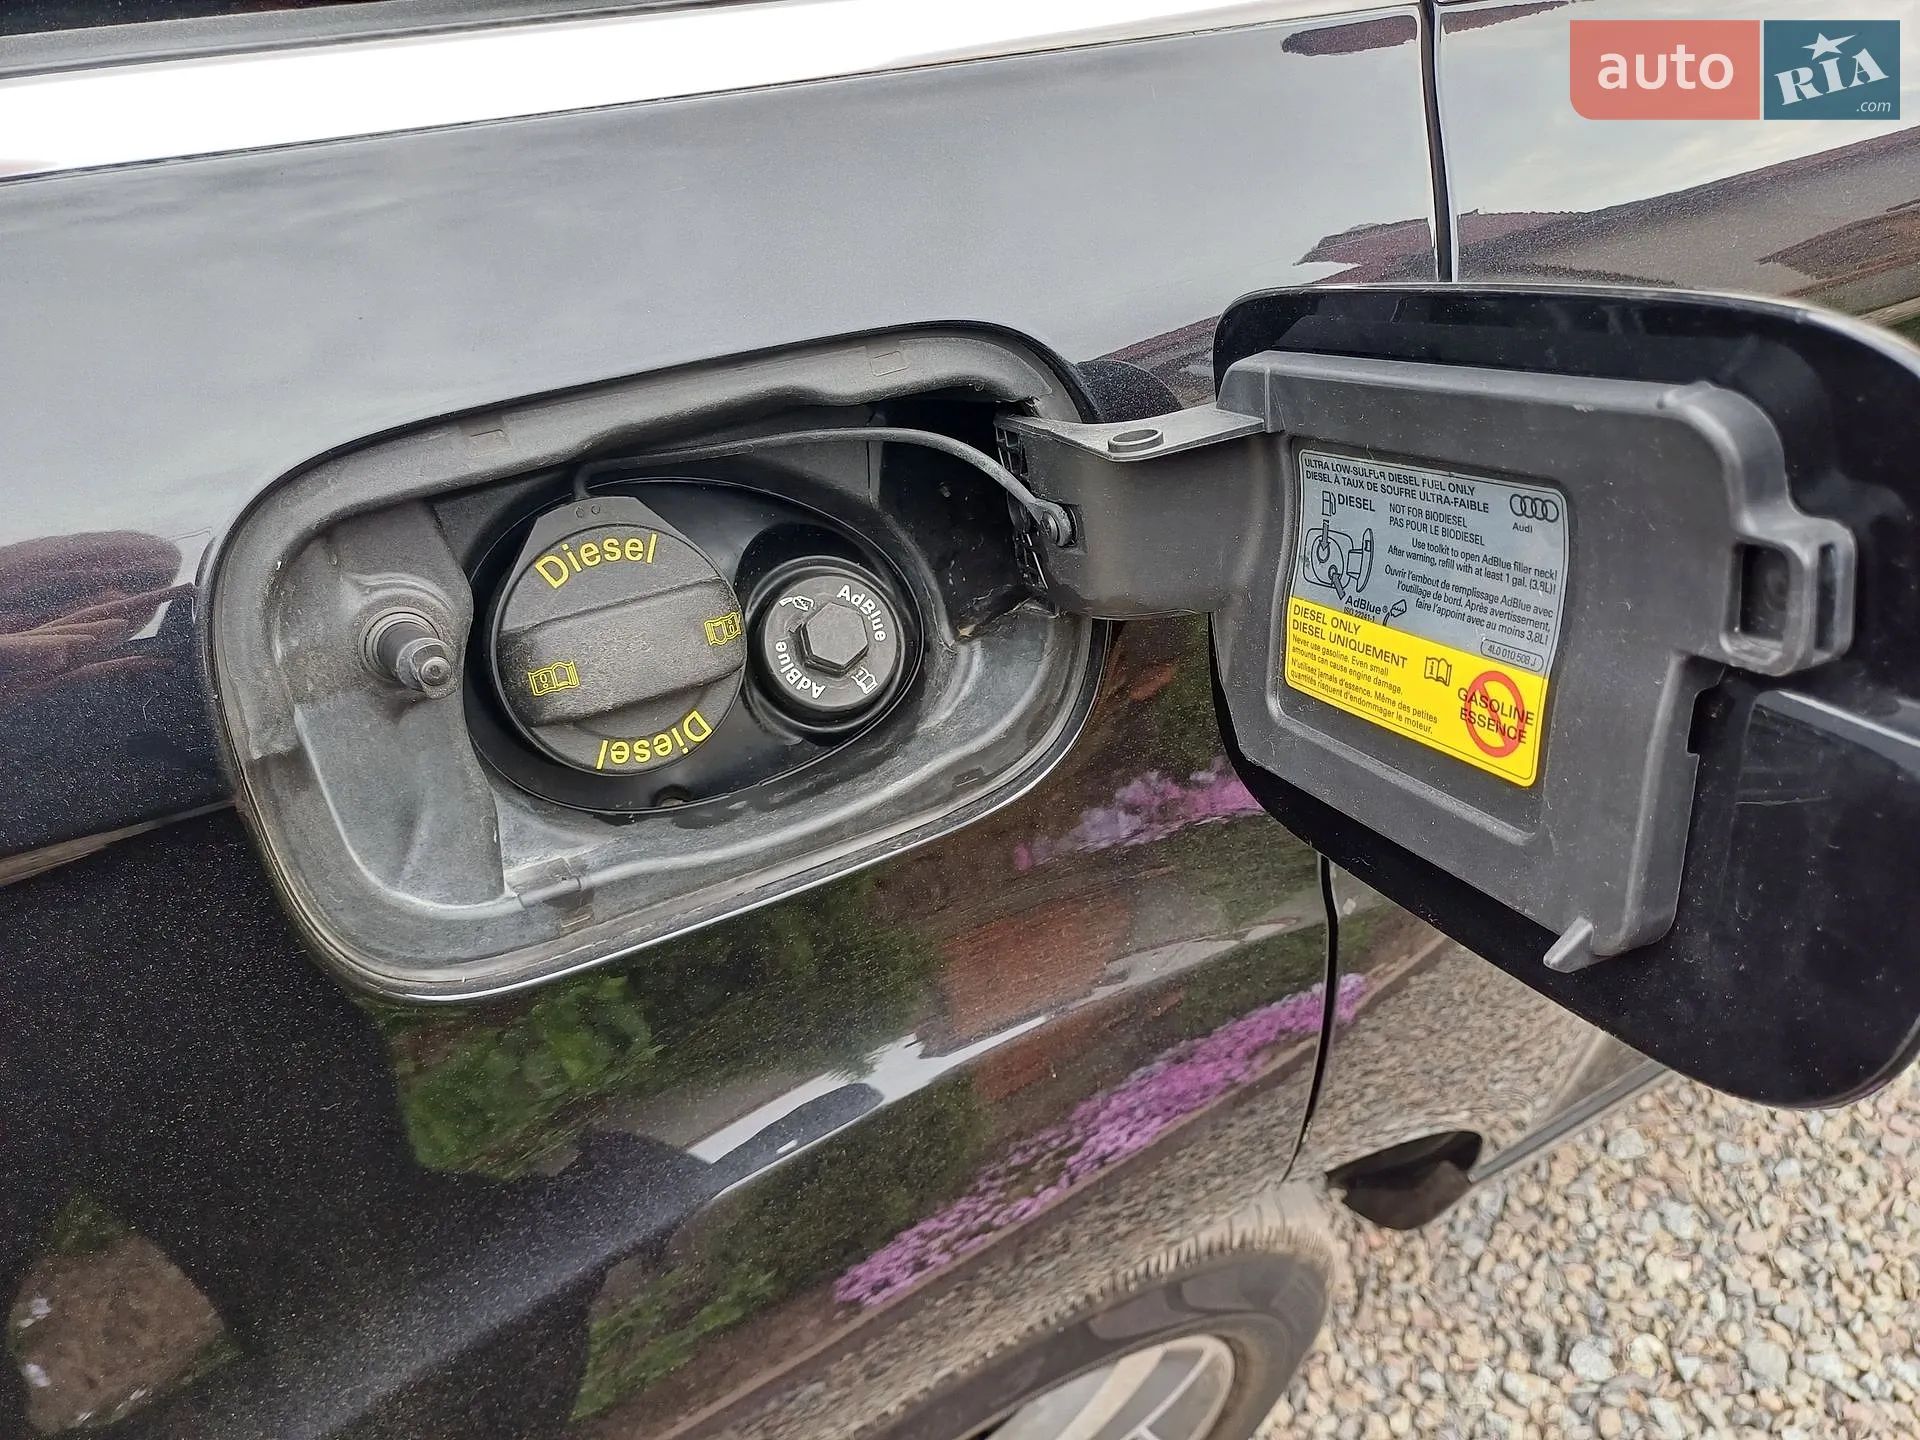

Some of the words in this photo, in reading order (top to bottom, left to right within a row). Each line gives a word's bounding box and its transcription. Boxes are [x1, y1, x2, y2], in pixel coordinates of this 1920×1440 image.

[1304, 458, 1329, 470] ULTRA
[1332, 462, 1386, 480] LOW-SULFUR
[1388, 472, 1420, 486] DIESEL
[1422, 478, 1445, 491] FUEL
[1448, 482, 1475, 496] ONLY
[1306, 470, 1332, 483] DIESEL
[1334, 474, 1340, 484] À
[1342, 477, 1364, 490] TAUX
[1367, 482, 1378, 492] DE
[1380, 484, 1416, 499] SOUFRE
[1420, 492, 1489, 513] ULTRA-FAIBLE
[1338, 494, 1376, 512] DIESEL
[1390, 503, 1406, 514] NOT
[1408, 507, 1423, 518] FOR
[1426, 510, 1468, 528] BIODIESEL
[1390, 516, 1404, 528] PAS
[1406, 520, 1427, 533] POUR
[1430, 524, 1439, 535] LE
[1442, 527, 1485, 546] BIODIESEL
[1512, 522, 1532, 533] Audi
[535, 533, 658, 588] Diesel
[1388, 545, 1405, 557] After
[1438, 558, 1454, 569] refill
[1456, 562, 1473, 574] with
[1475, 567, 1482, 576] at
[1484, 567, 1503, 581] least
[1506, 573, 1509, 583] 1
[1512, 576, 1527, 587] gal.
[1412, 538, 1425, 549] Use
[1427, 542, 1449, 555] toolkit
[1451, 547, 1459, 557] to
[1461, 551, 1480, 562] open
[1482, 554, 1512, 570] AdBlue
[1514, 561, 1532, 574] filler
[1384, 564, 1406, 578] Ouvrir
[1440, 580, 1450, 590] de
[1451, 584, 1499, 604] remplissage
[1500, 595, 1531, 612] AdBlue
[1533, 605, 1554, 618] avec
[1432, 591, 1442, 600] de
[1444, 593, 1463, 608] bord.
[1464, 599, 1489, 614] Après
[836, 584, 886, 641] AdBlue
[1294, 604, 1327, 626] DIESEL
[1331, 617, 1361, 635] ONLY
[1416, 598, 1432, 611] faire
[1467, 615, 1485, 627] avec
[1486, 621, 1496, 630] au
[1498, 625, 1525, 639] moins
[1292, 646, 1316, 661] amounts
[1318, 656, 1328, 666] can
[1330, 661, 1347, 673] cause
[1349, 668, 1371, 682] engine
[1293, 620, 1325, 640] DIESEL
[1329, 632, 1408, 669] UNIQUEMENT
[1293, 634, 1309, 647] Never
[1310, 643, 1320, 651] use
[1352, 656, 1368, 669] Even
[1370, 664, 1389, 676] small
[1502, 648, 1516, 660] 010
[1531, 658, 1537, 666] J
[776, 641, 826, 699] AdBlue
[1291, 670, 1316, 686] quantités
[1318, 679, 1342, 697] risquent
[1396, 712, 1403, 721] le
[1405, 717, 1432, 734] moteur.
[1318, 668, 1337, 683] jamais
[1374, 691, 1396, 707] Même
[1398, 701, 1410, 713] des
[1412, 708, 1438, 724] petites
[1458, 687, 1534, 726] GASOLINE
[596, 710, 712, 770] Diesel
[1460, 707, 1527, 744] ESSENCE
